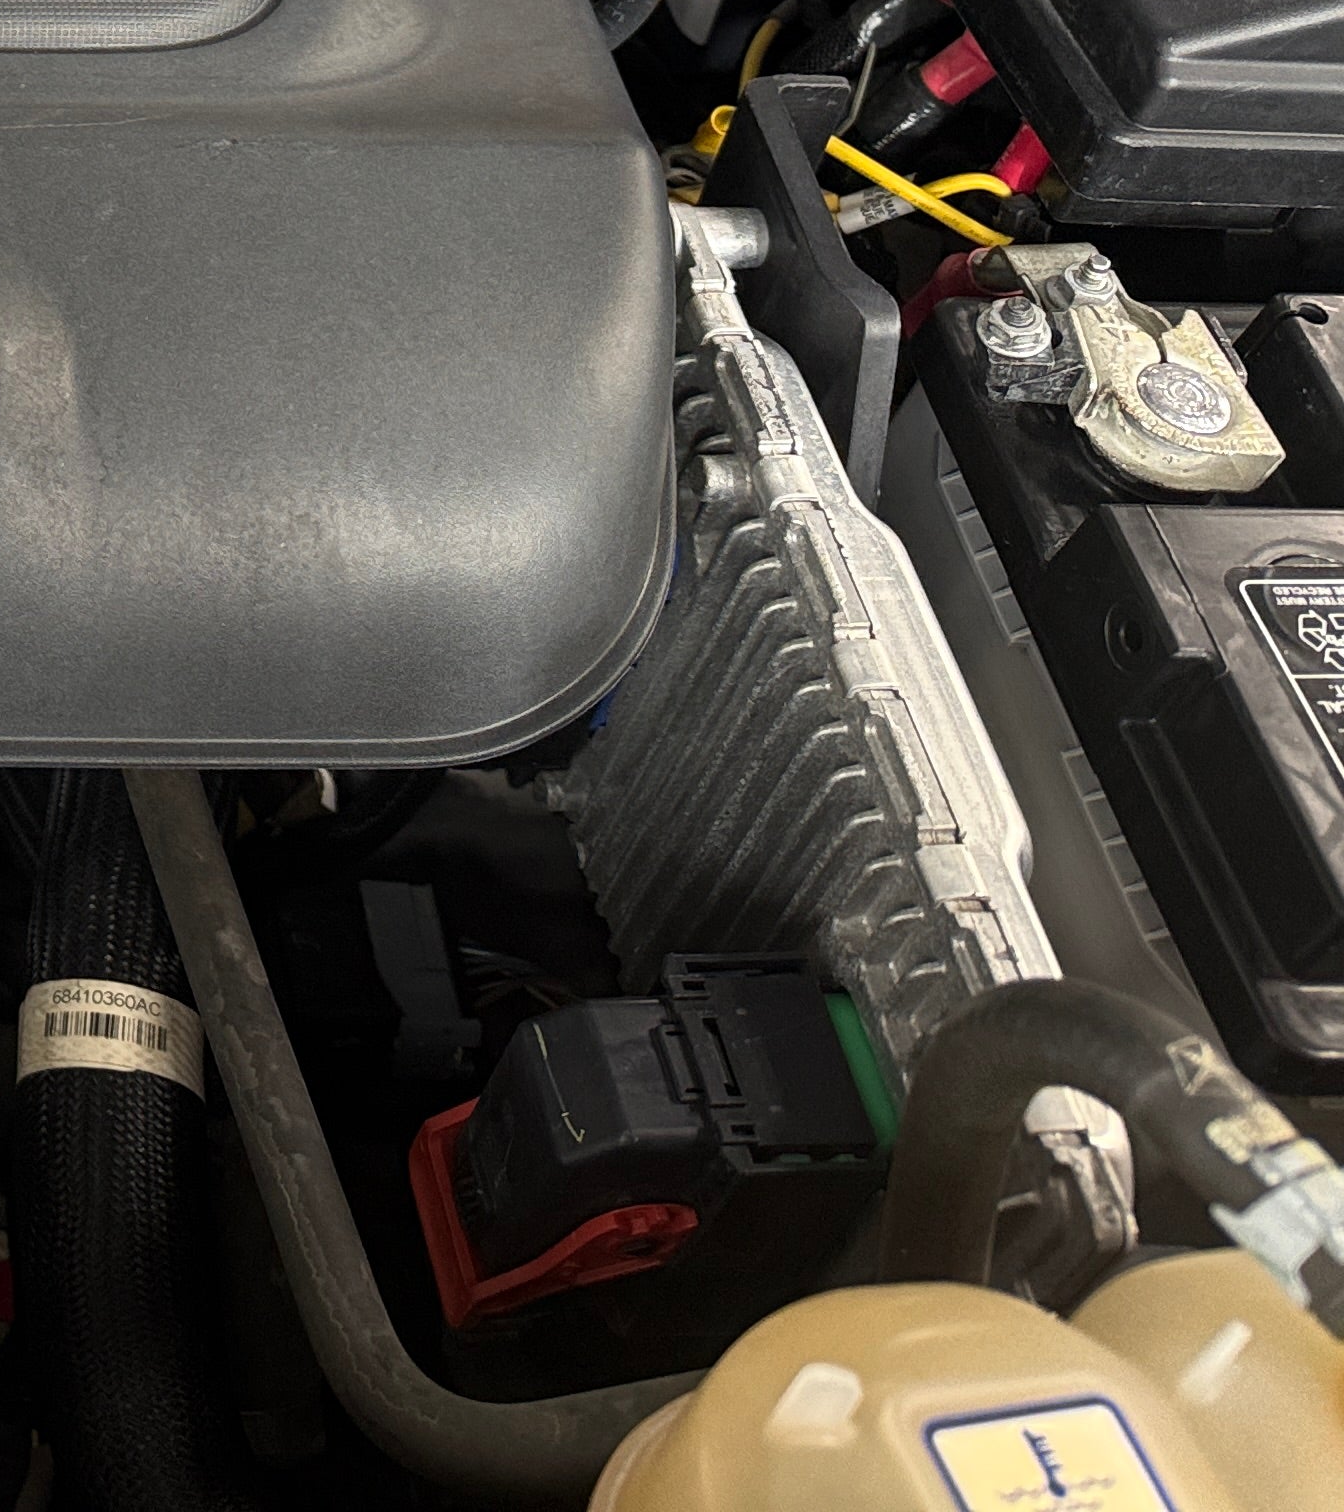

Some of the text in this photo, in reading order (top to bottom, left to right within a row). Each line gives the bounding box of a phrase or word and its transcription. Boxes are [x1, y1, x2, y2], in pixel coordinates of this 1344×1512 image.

[1272, 586, 1333, 596] RECYCLED
[1275, 596, 1308, 606] MUST
[51, 988, 162, 1018] 68410360AC
